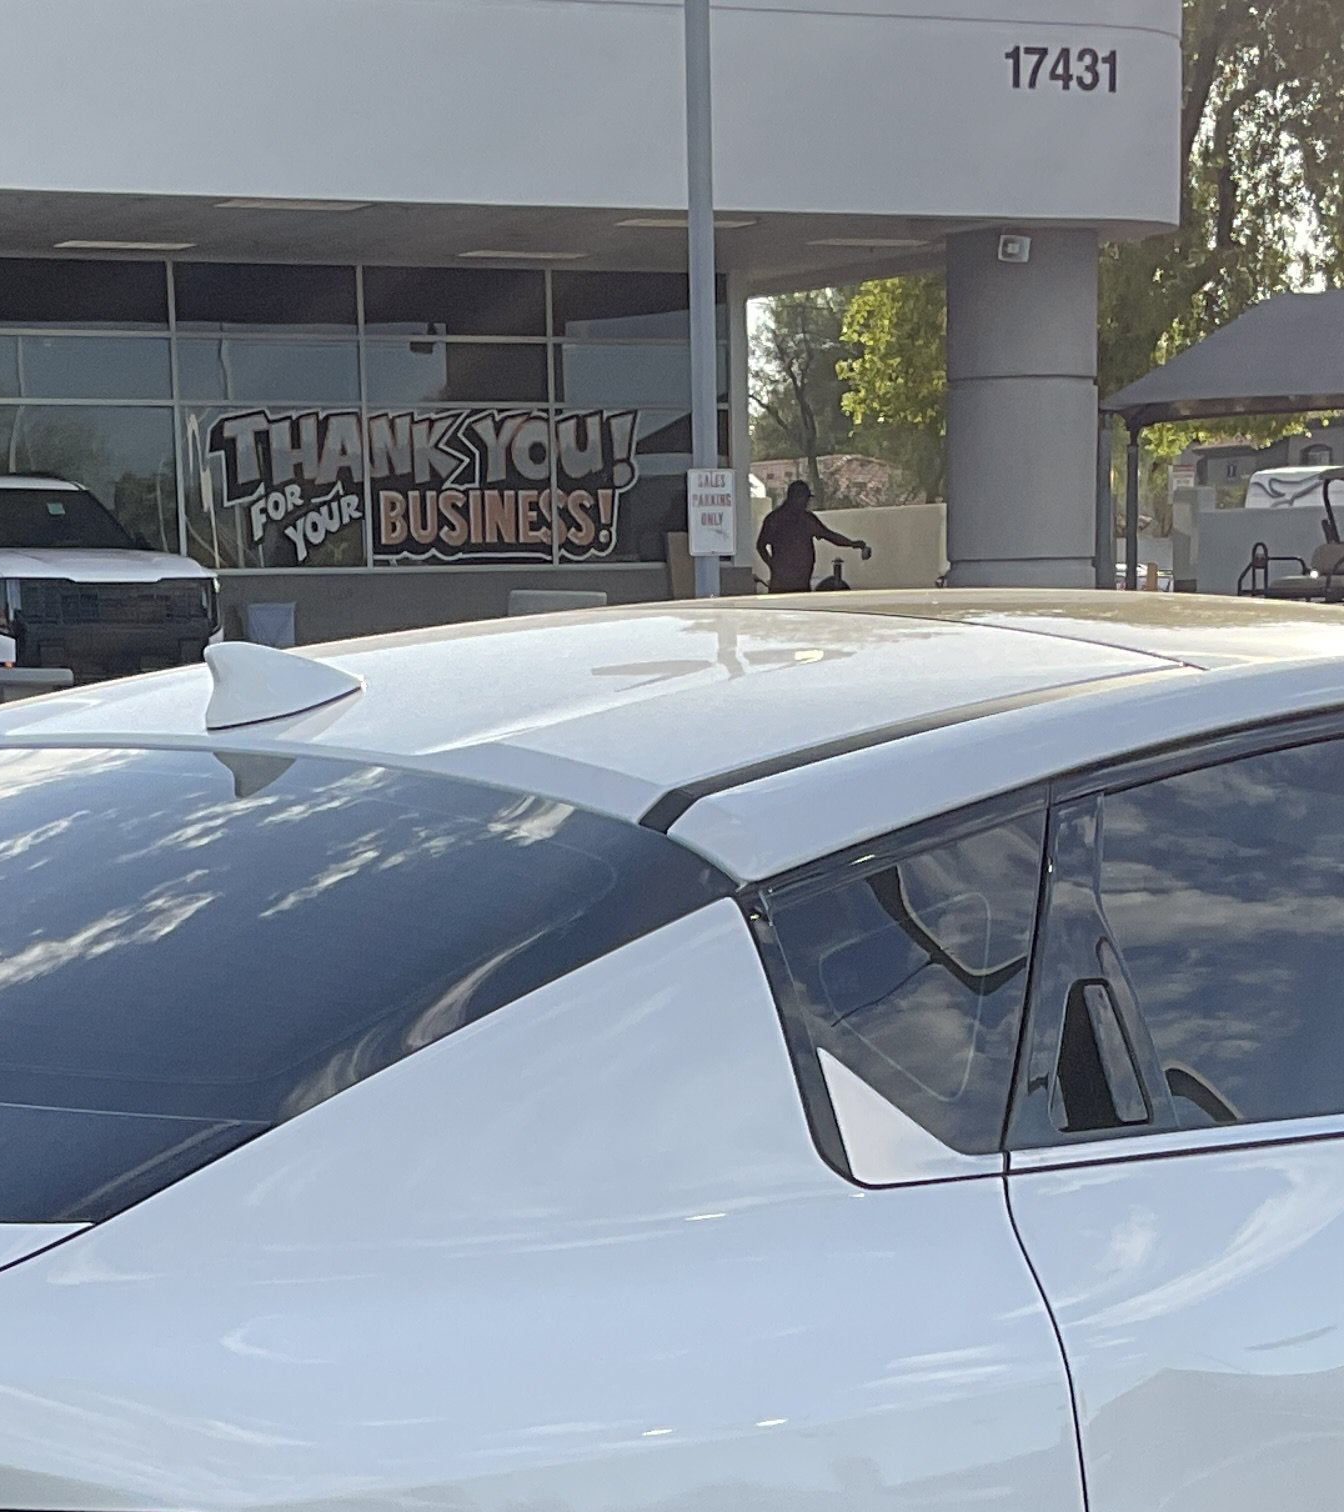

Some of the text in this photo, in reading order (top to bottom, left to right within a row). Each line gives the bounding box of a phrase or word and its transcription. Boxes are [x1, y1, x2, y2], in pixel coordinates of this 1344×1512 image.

[1005, 45, 1117, 93] 17431
[223, 408, 636, 487] THANK YOU!
[250, 483, 304, 543] FOR
[284, 494, 363, 562] YOUR
[379, 488, 613, 547] BUSINESS!
